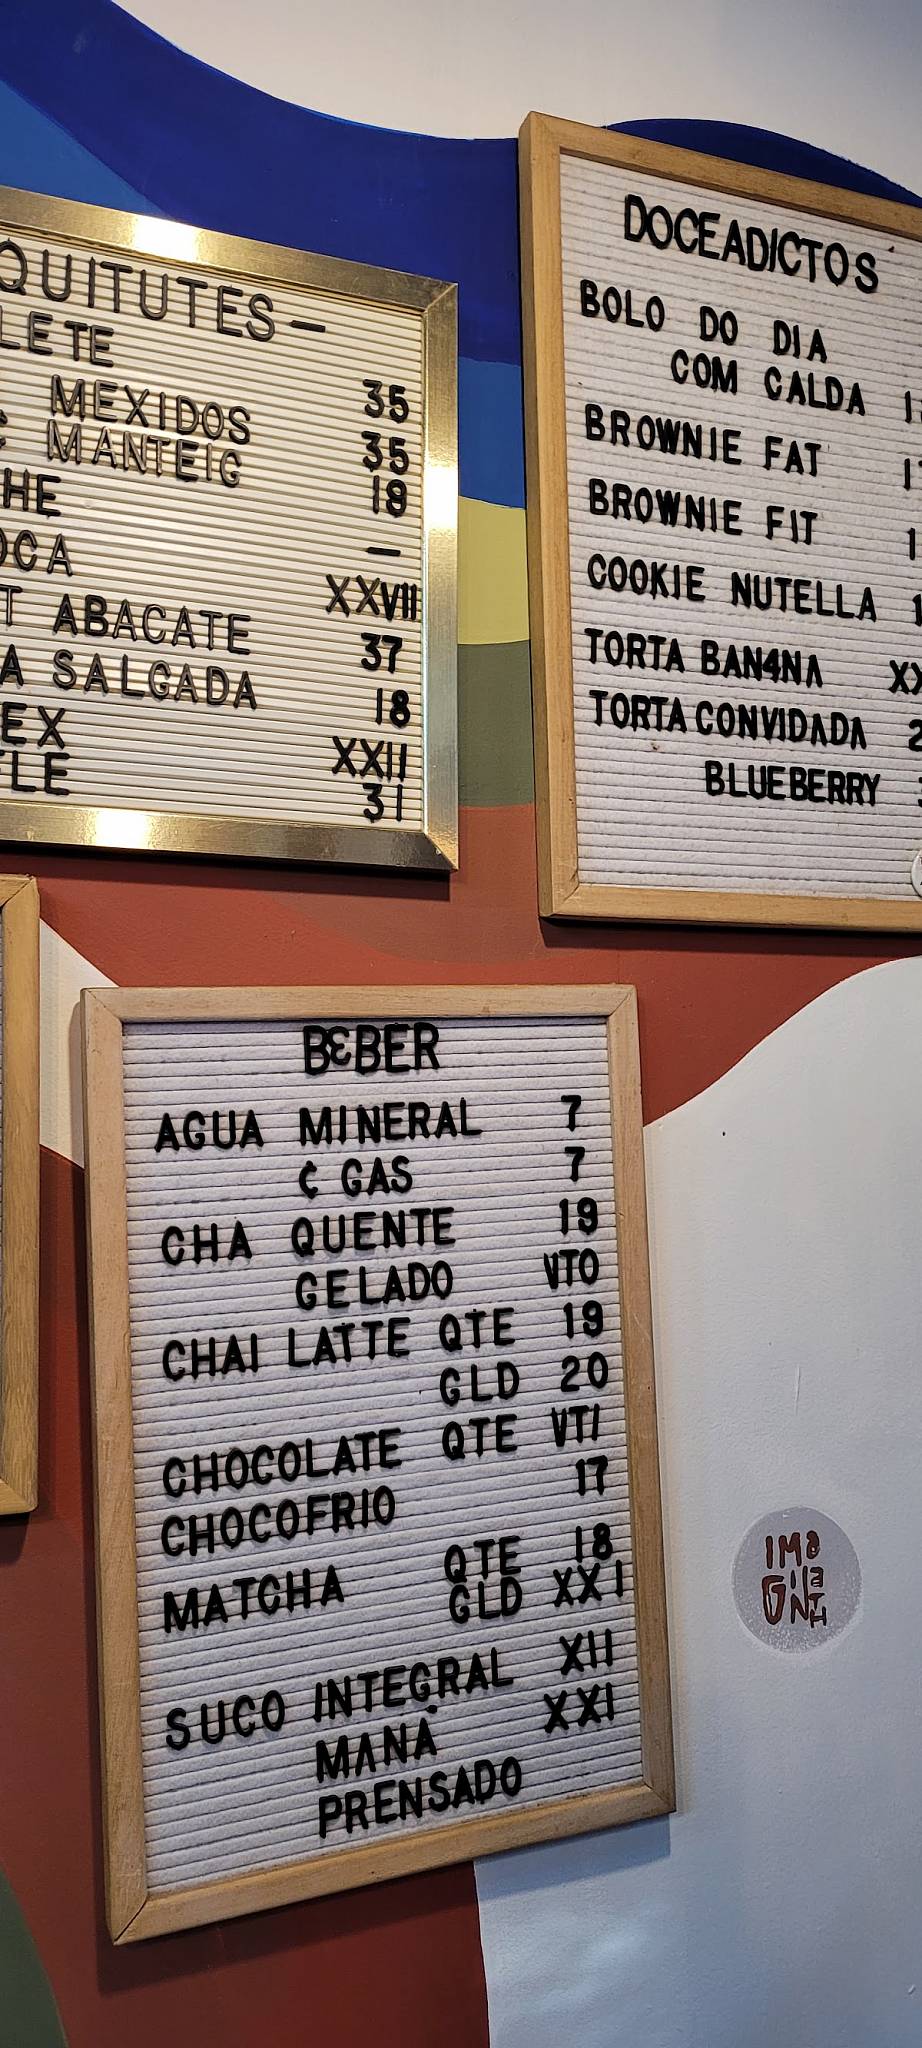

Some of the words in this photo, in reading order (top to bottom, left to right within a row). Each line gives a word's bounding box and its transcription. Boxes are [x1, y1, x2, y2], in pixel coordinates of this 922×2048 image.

[624, 194, 880, 294] DOCEADICTOS
[580, 278, 667, 333] BOLO
[698, 304, 740, 346] DO
[771, 318, 829, 364] DIA
[361, 378, 411, 424] 35
[669, 347, 739, 395] COM
[762, 365, 868, 417] CALDA
[46, 418, 243, 489] MANTEIG
[49, 374, 252, 446] MEXIDOS
[360, 430, 411, 475] 35
[584, 402, 743, 466] BROWNIE
[762, 434, 823, 478] FAT
[588, 477, 743, 537] BROWNIE
[765, 504, 820, 546] FIT
[325, 573, 418, 622] XXVII
[587, 552, 706, 603] COOKIE
[730, 570, 878, 623] NUTELLA
[53, 593, 252, 655] ABACATE
[360, 632, 403, 673] 37
[583, 627, 686, 674] TORTA
[52, 648, 258, 710] SALGADA
[374, 687, 412, 728] 18
[588, 689, 688, 734] TORTA
[695, 700, 868, 751] CONVIDADA
[330, 735, 409, 782] XXII
[703, 759, 881, 807] BLUEBERRY
[153, 1108, 266, 1153] AGUA
[298, 1097, 484, 1147] MINERAL
[560, 1094, 583, 1132] 7
[340, 1155, 414, 1197] GAS
[563, 1146, 587, 1182] 7
[160, 1221, 254, 1266] CHA
[289, 1206, 457, 1258] QUENTE
[558, 1197, 600, 1236] 19
[294, 1260, 454, 1312] GELADO
[542, 1247, 600, 1290] VTO
[161, 1333, 259, 1382] CHAI
[287, 1316, 412, 1367] LATTE
[438, 1306, 516, 1353] QTE
[562, 1300, 605, 1339] 19
[438, 1360, 521, 1408] GLD
[560, 1352, 609, 1393] 20
[161, 1427, 403, 1498] CHOCOLATE
[440, 1412, 518, 1461] QTE
[160, 1485, 396, 1557] CHOCOFRIO
[574, 1454, 608, 1496] 17
[163, 1564, 345, 1633] MATCHA
[442, 1534, 522, 1584] QTE
[574, 1522, 613, 1563] 18
[447, 1575, 523, 1625] GLD
[165, 1689, 286, 1751] SUCO
[311, 1646, 514, 1724] INTEGRAL
[558, 1628, 614, 1676] XII
[543, 1681, 616, 1734] XXI
[317, 1755, 523, 1839] PRENSADO
